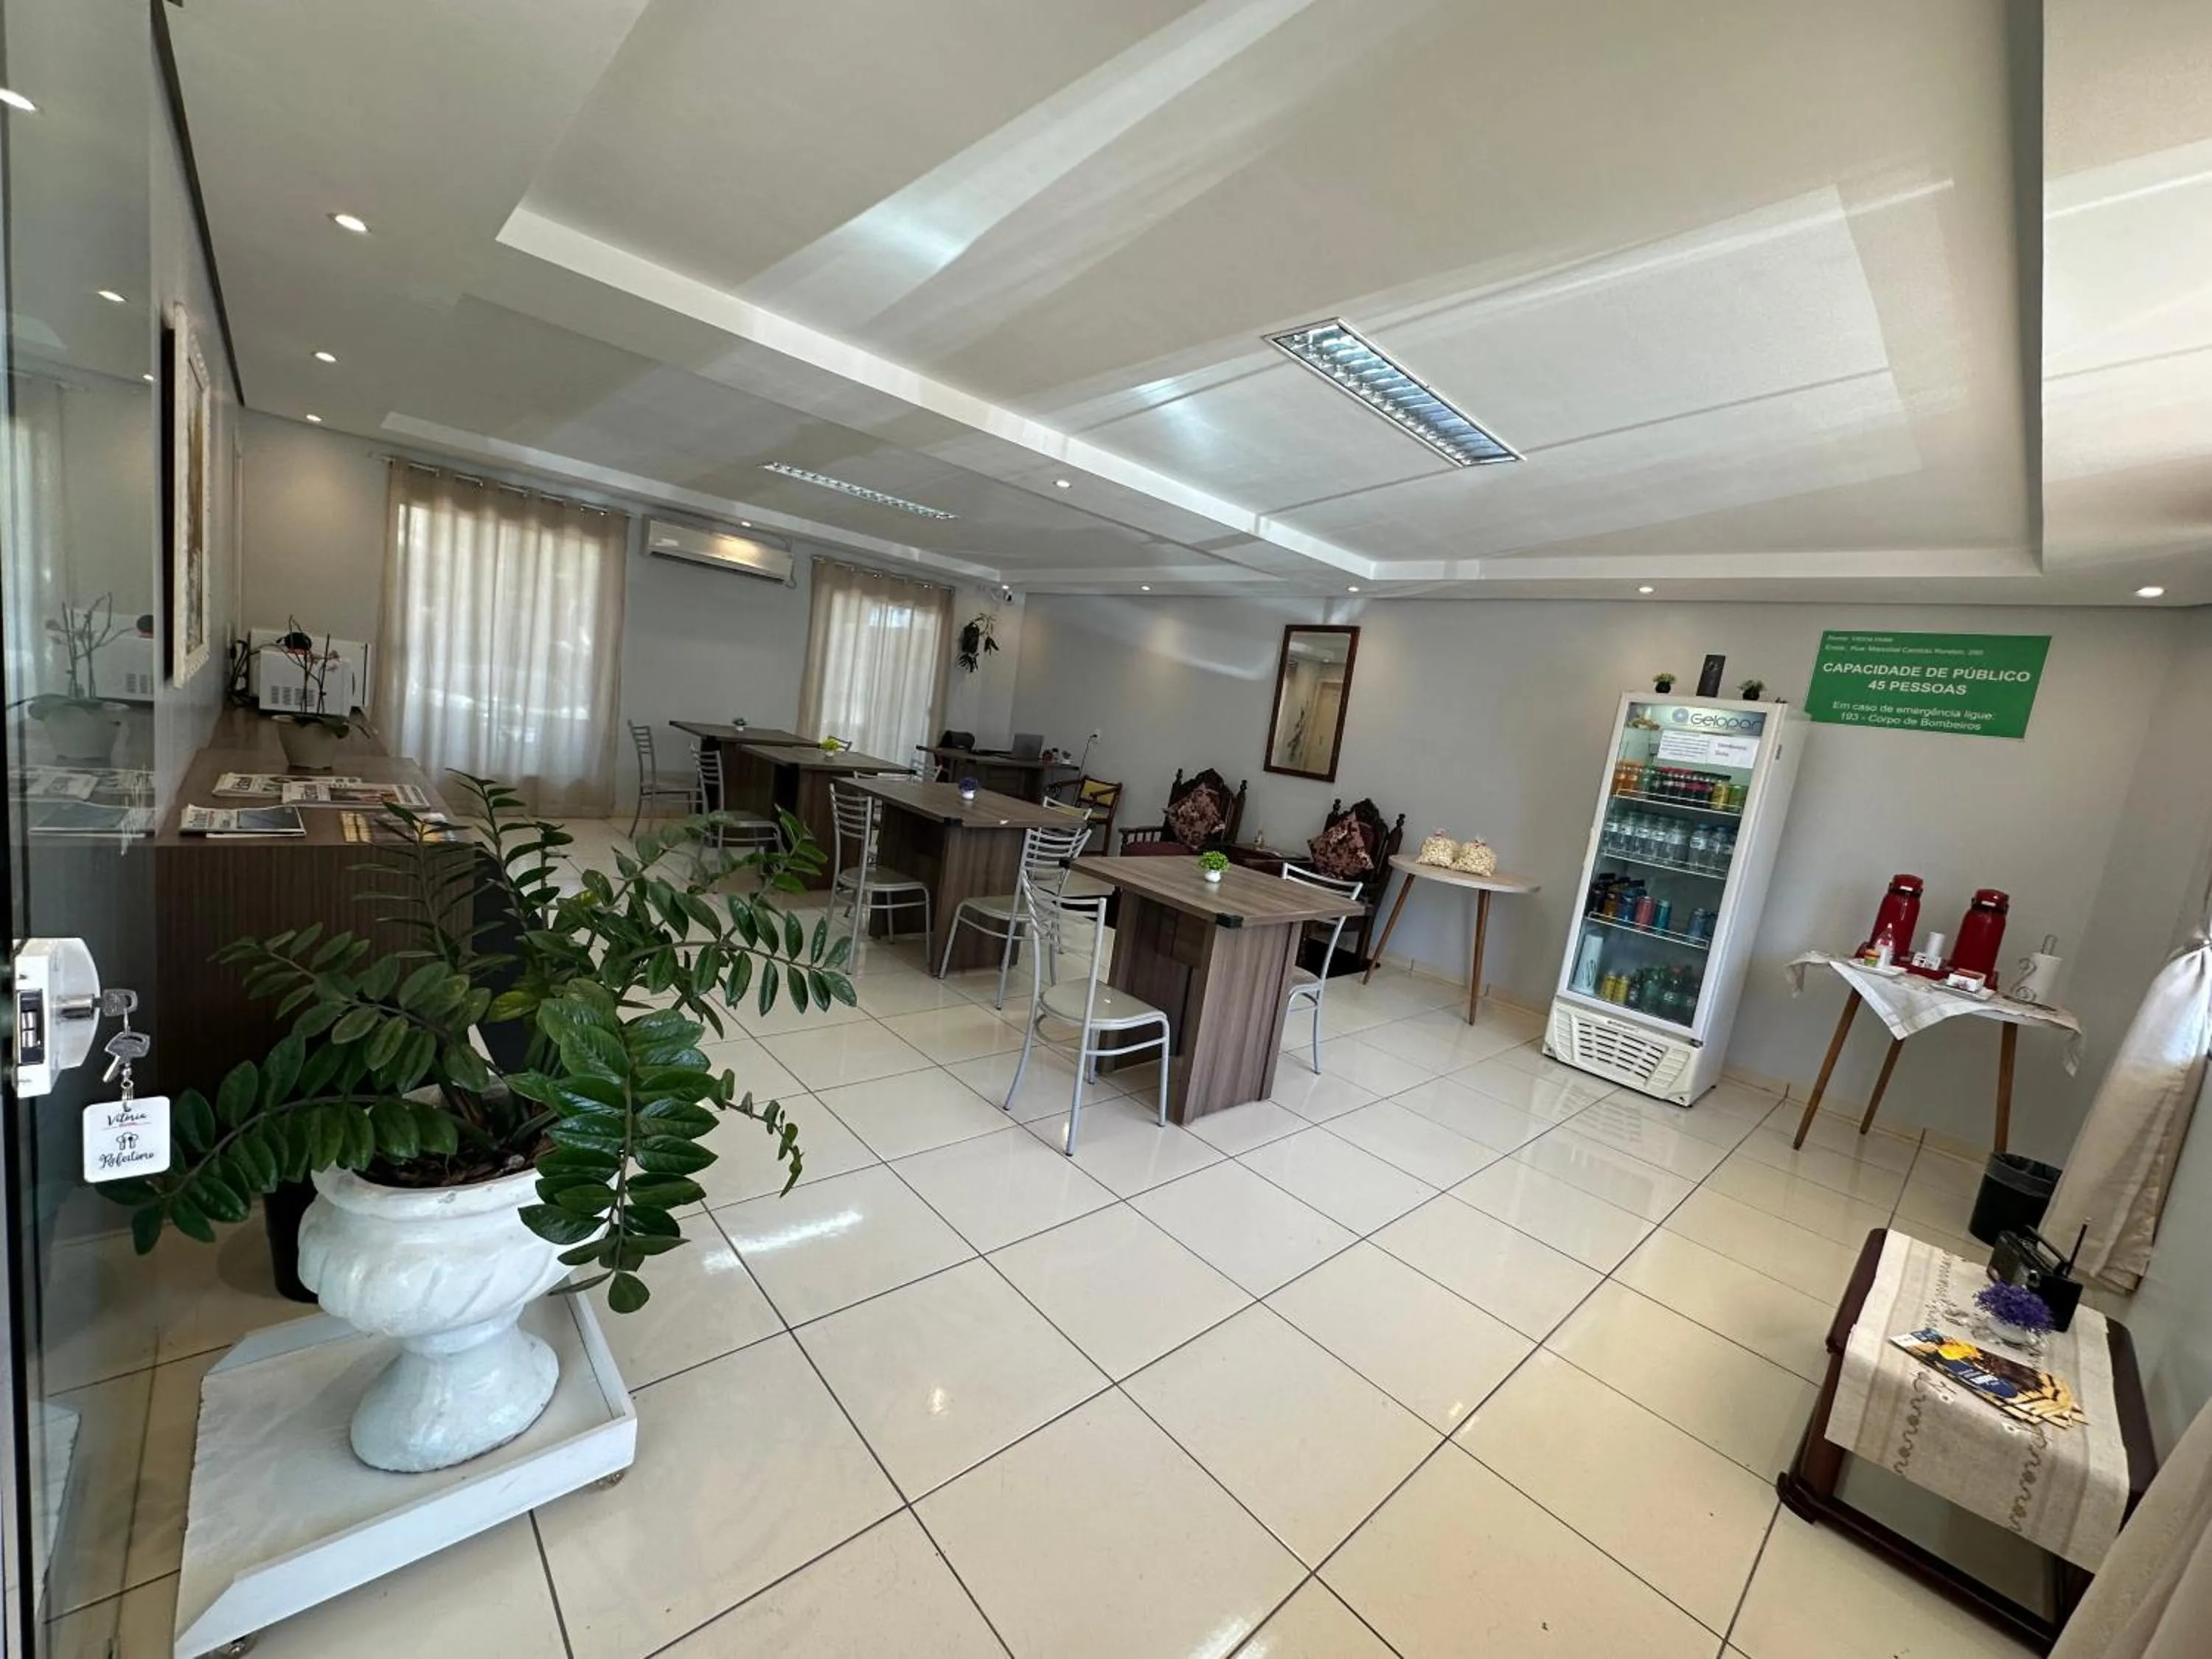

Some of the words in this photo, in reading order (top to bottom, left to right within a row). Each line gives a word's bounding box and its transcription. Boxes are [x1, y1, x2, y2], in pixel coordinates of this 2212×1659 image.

[1823, 663, 1924, 678] CAPACIDADE
[1925, 667, 1948, 678] DE
[1952, 666, 2031, 682] PÚBLICO
[1868, 681, 1885, 689] 45
[1889, 681, 1968, 695] PESSOAS
[1832, 701, 1850, 710] Em
[1879, 703, 1893, 713] de
[1896, 707, 1962, 718] emergência
[1840, 712, 1859, 722] 193
[1868, 714, 1901, 726] Corpo
[1903, 717, 1918, 726] de
[1920, 717, 1981, 731] Bombeiros
